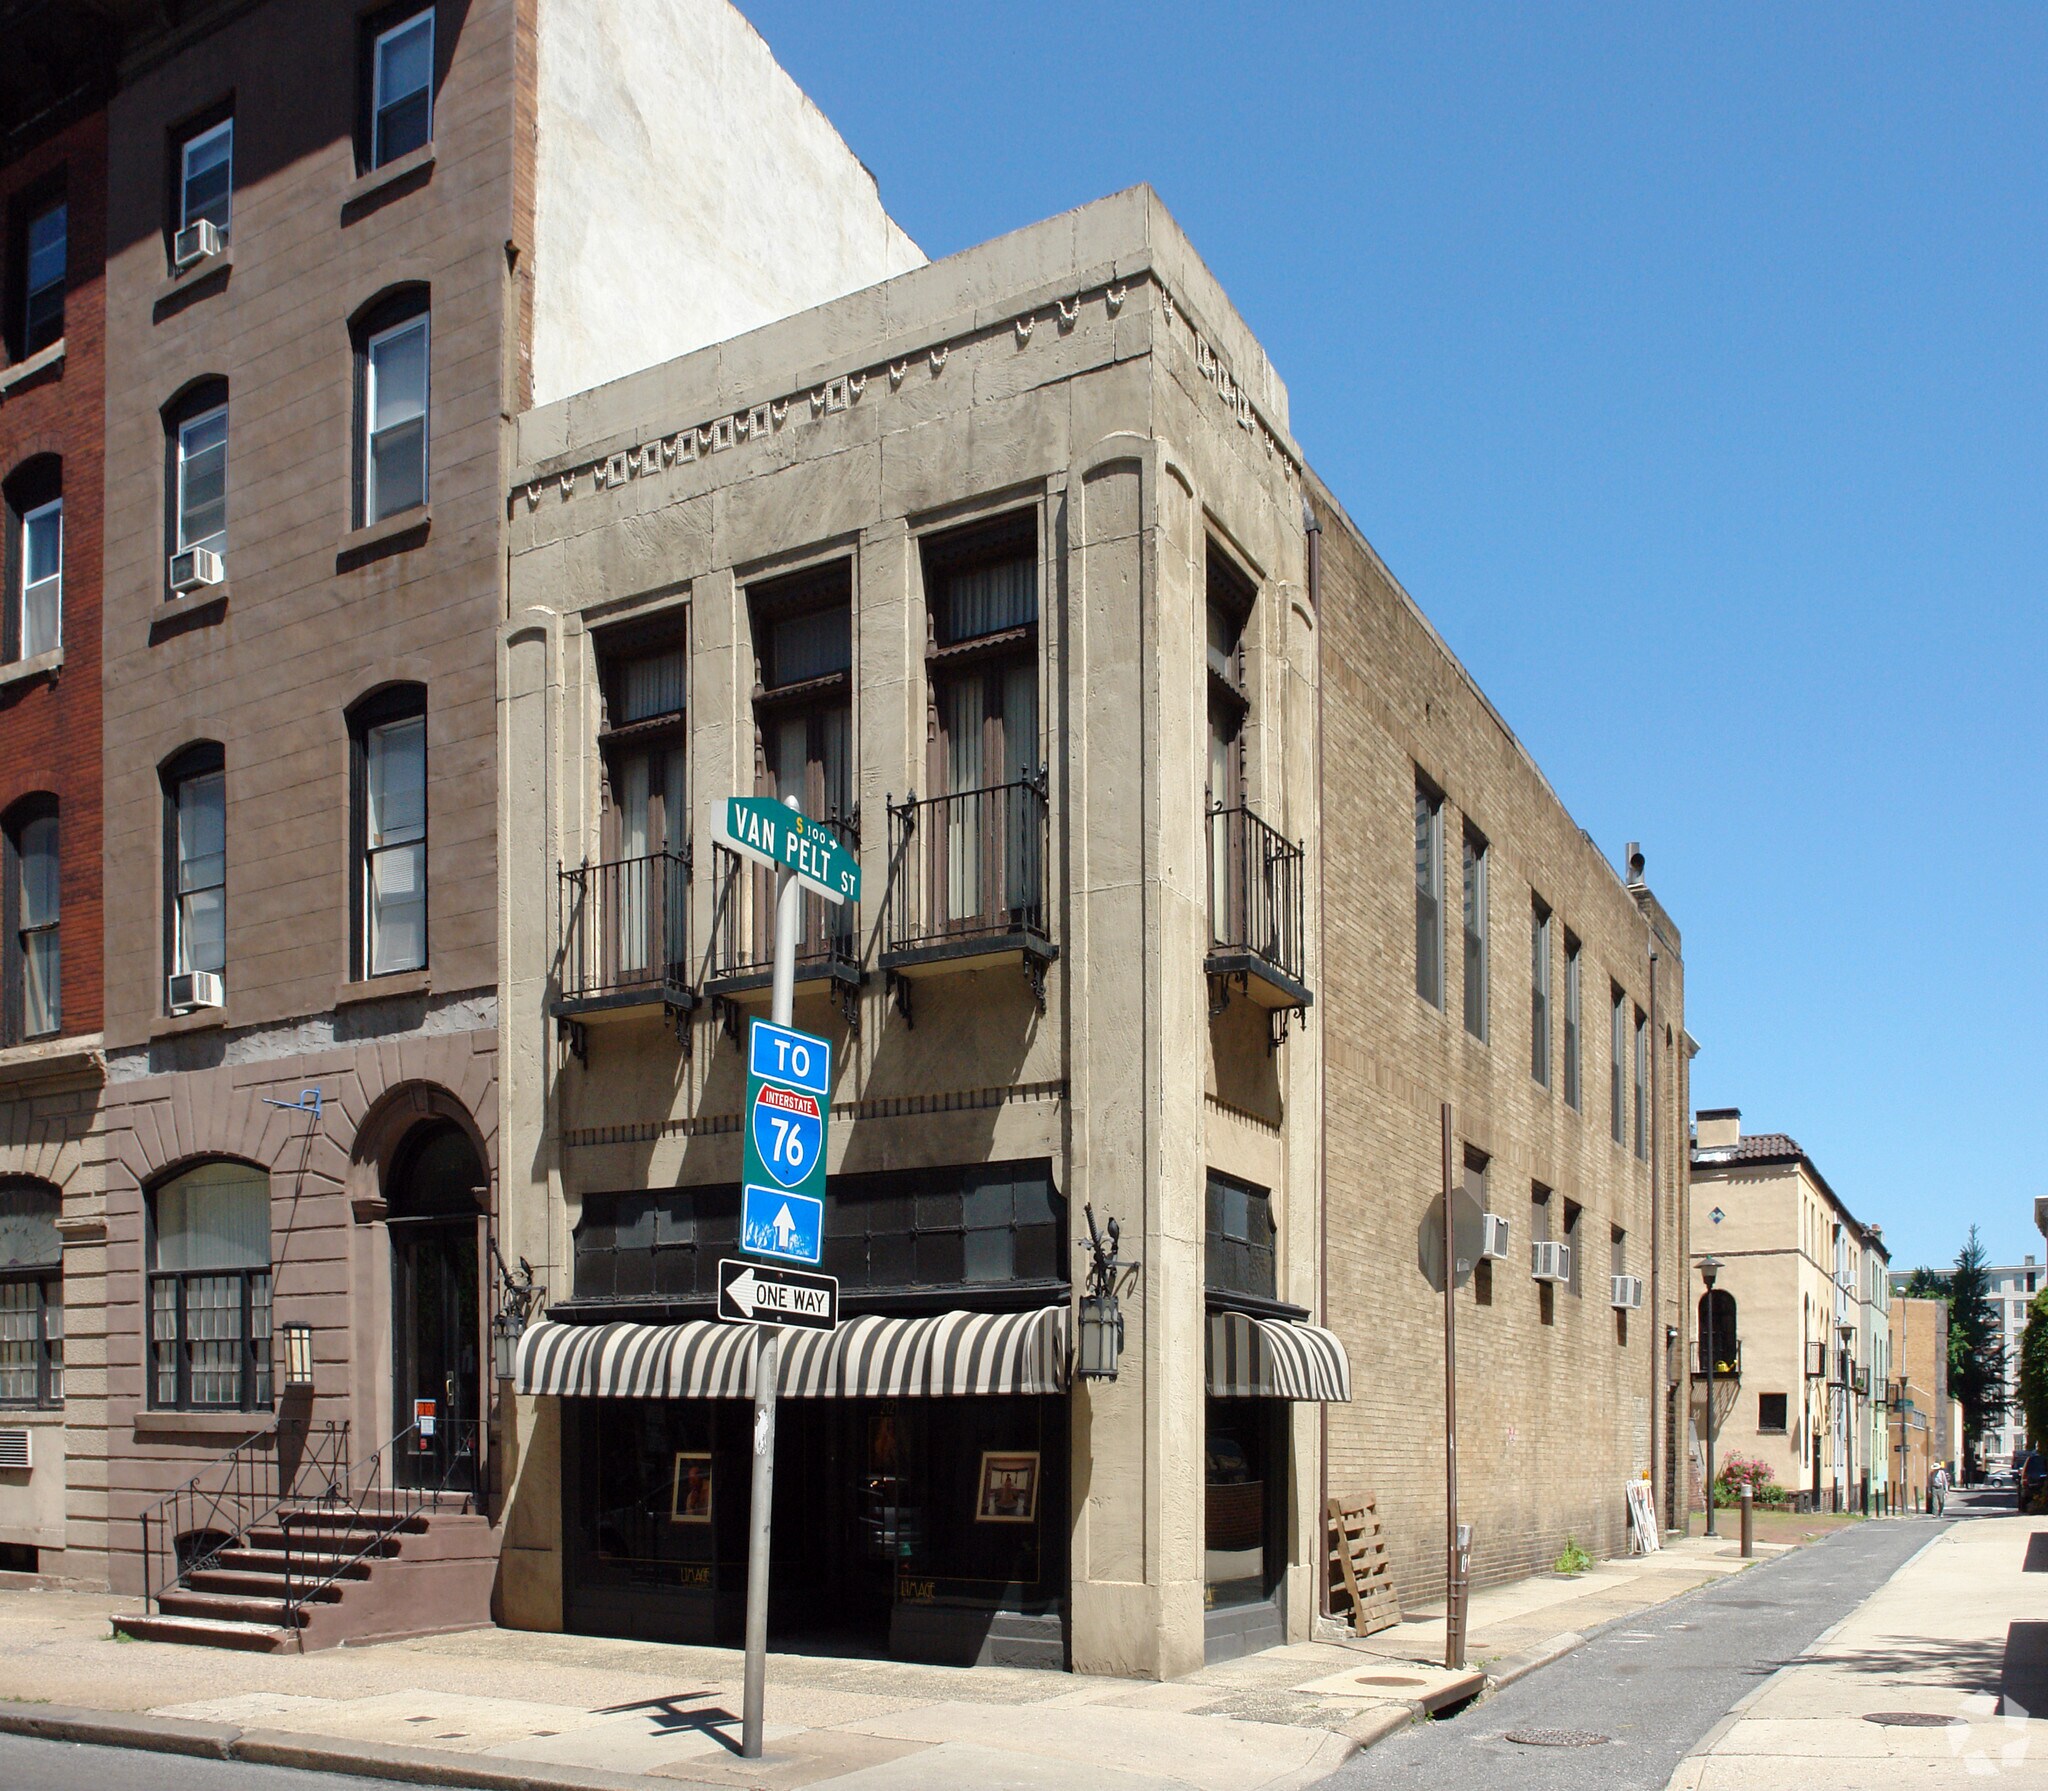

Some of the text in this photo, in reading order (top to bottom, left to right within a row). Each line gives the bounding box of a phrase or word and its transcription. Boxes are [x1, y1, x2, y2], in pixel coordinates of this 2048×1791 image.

[796, 817, 826, 844] S 100
[735, 803, 856, 896] VAN PELT ST
[774, 1039, 810, 1077] TO
[765, 1090, 812, 1114] INTERSTATE
[771, 1119, 804, 1166] 76
[756, 1283, 825, 1313] ONE WAY
